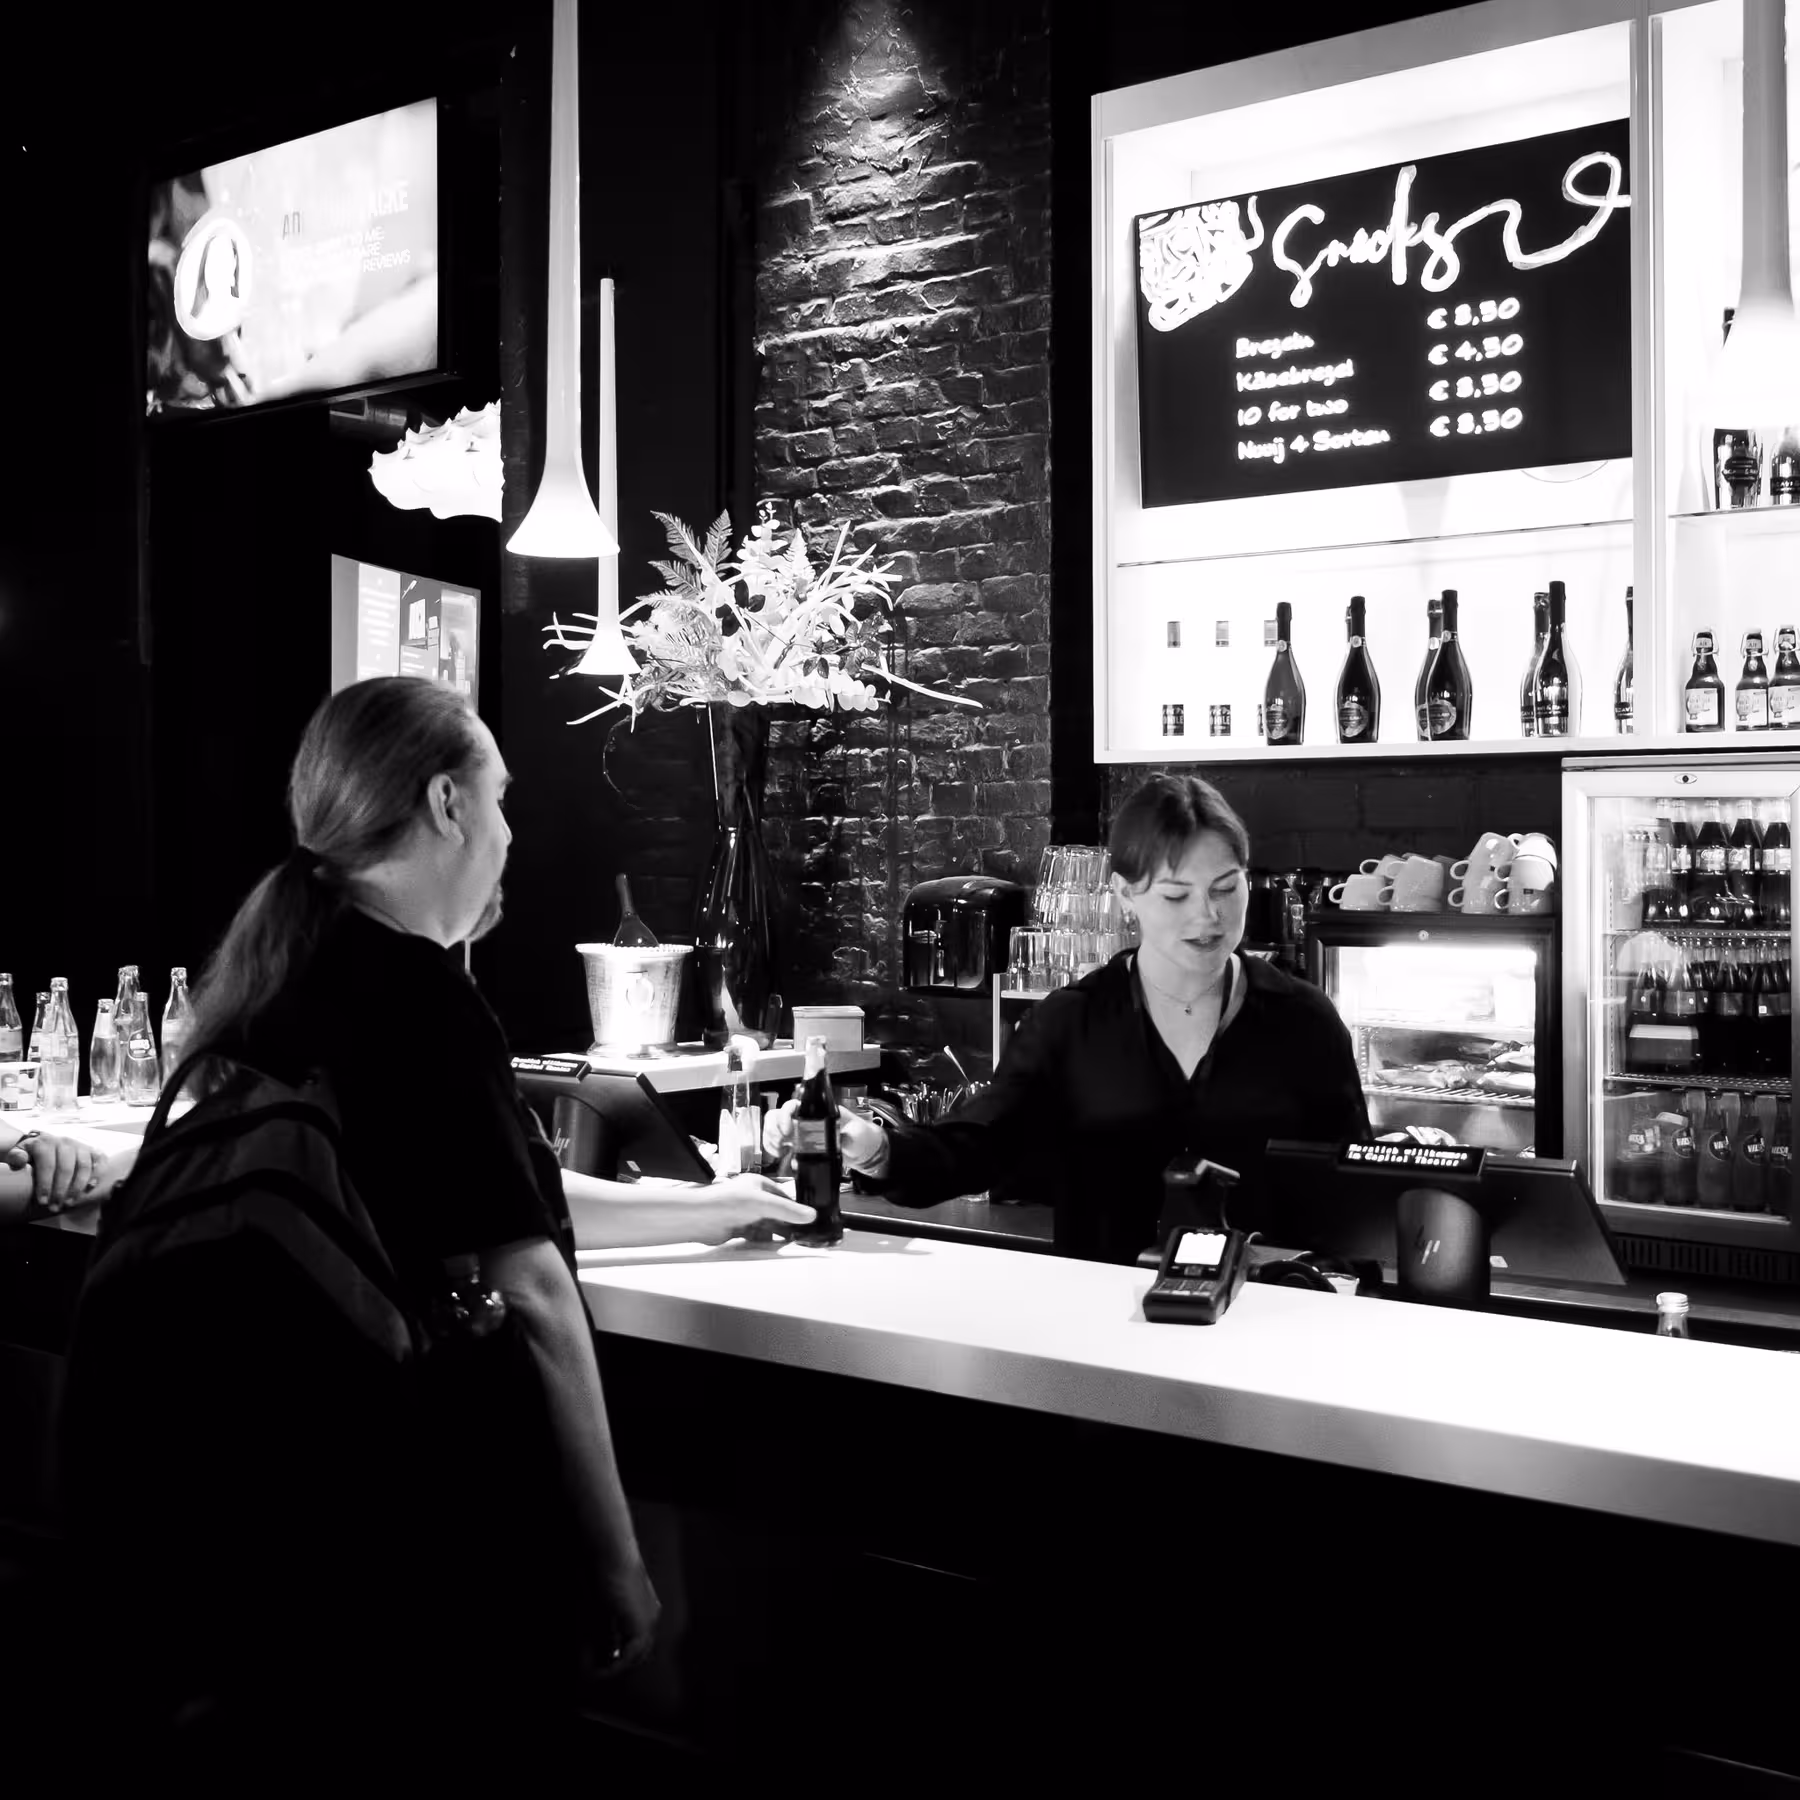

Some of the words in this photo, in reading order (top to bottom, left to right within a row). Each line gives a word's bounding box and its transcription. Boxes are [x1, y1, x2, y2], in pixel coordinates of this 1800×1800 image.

[363, 248, 411, 273] REVIEWS
[1455, 334, 1523, 361] 4,50
[1238, 406, 1262, 426] 10
[1268, 401, 1301, 422] for
[1306, 399, 1348, 417] two
[1290, 435, 1310, 453] 4
